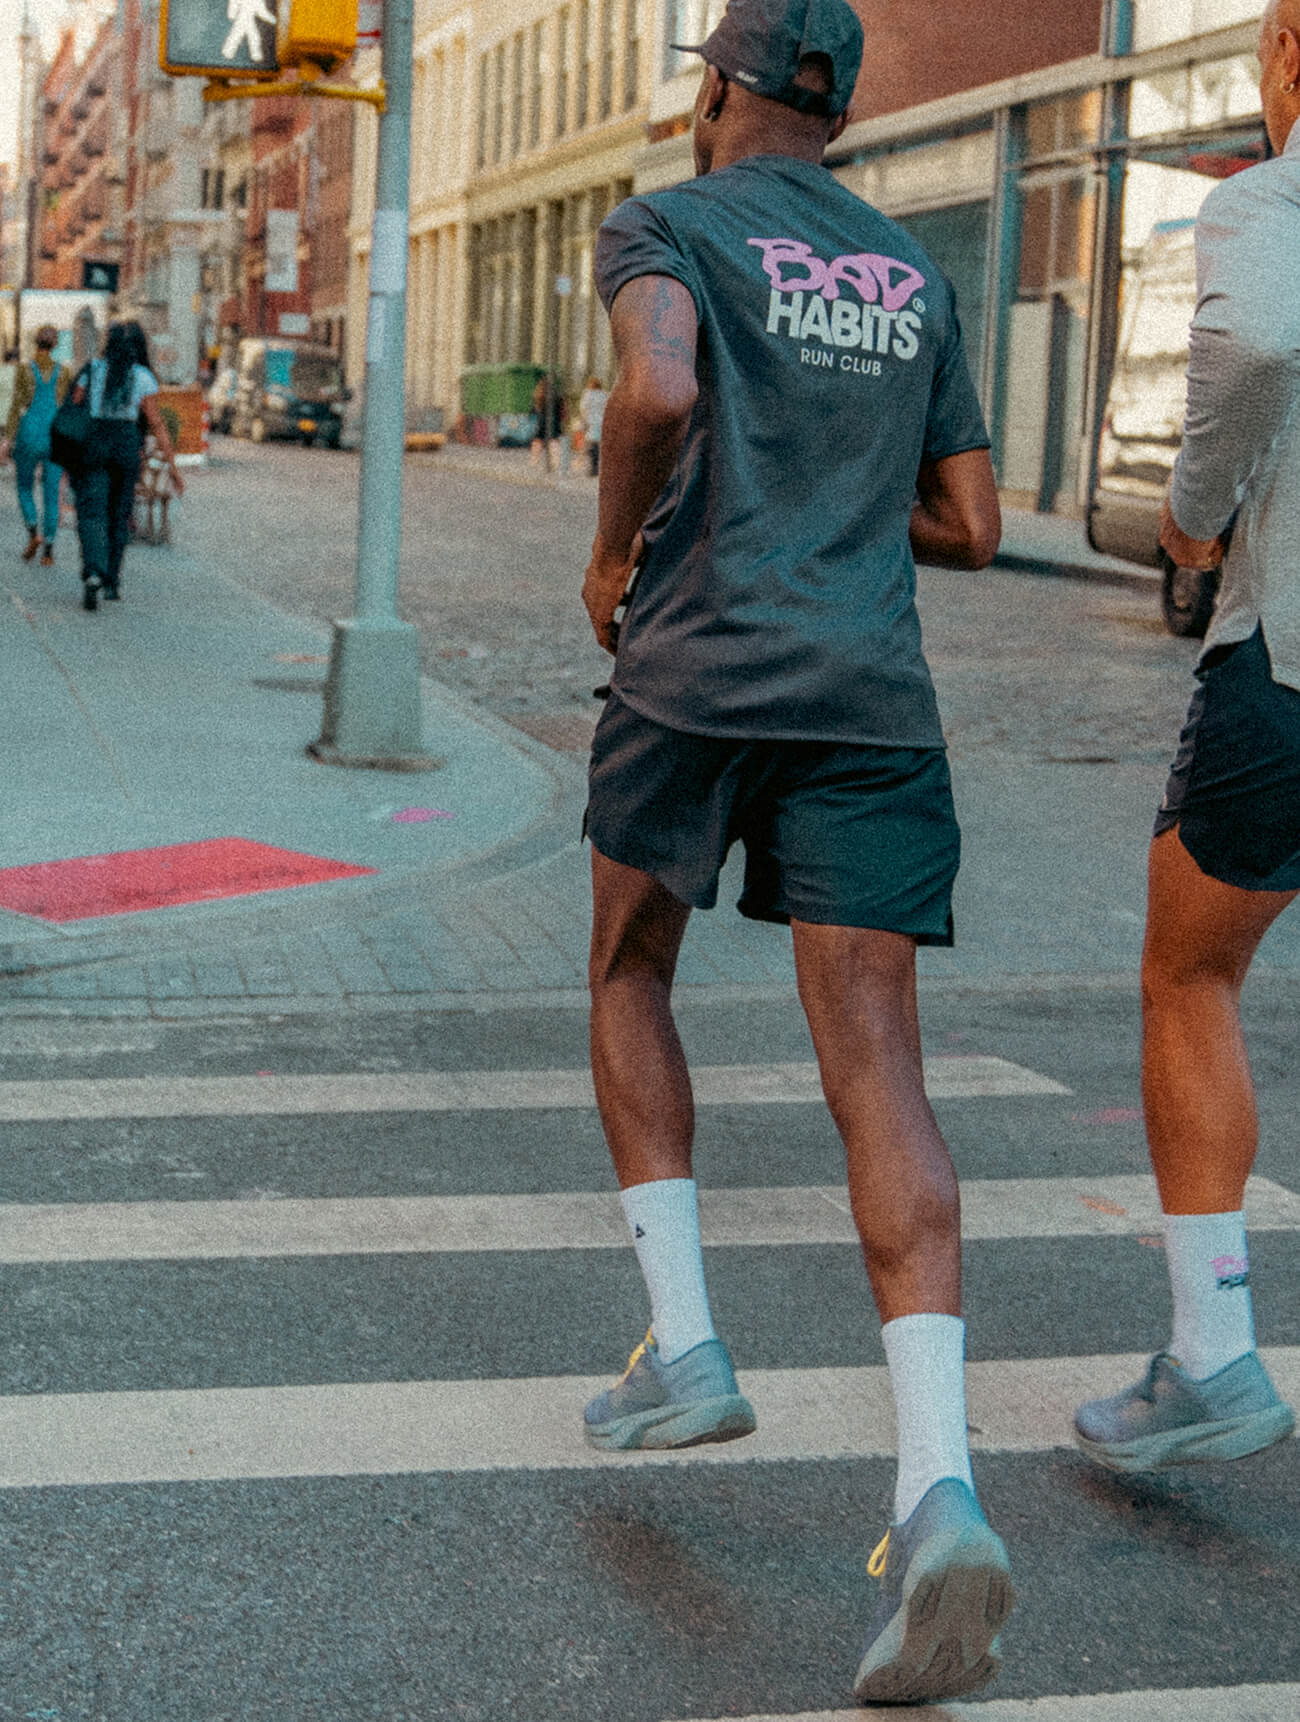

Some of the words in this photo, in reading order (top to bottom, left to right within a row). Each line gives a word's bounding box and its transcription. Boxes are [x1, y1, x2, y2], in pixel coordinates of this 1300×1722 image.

[747, 238, 926, 311] BAD
[766, 288, 922, 360] HABITS
[801, 348, 834, 368] RUN
[840, 355, 882, 376] CLUB
